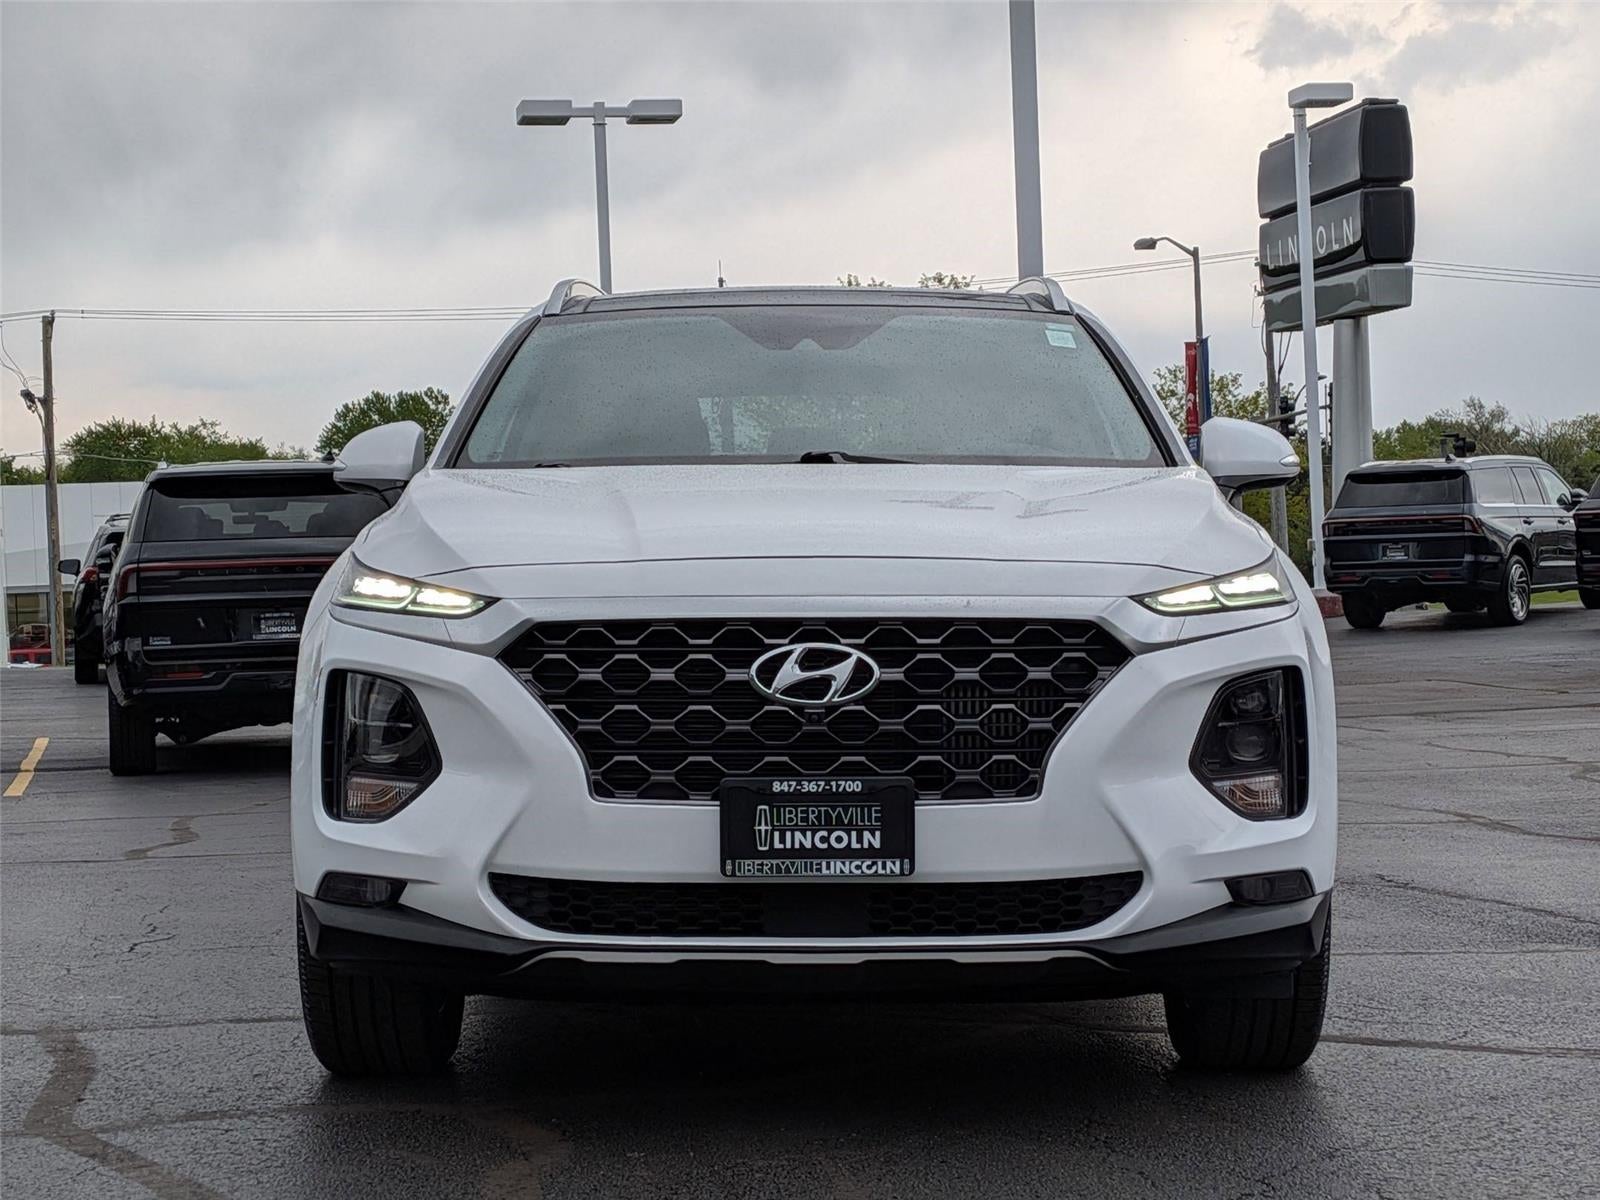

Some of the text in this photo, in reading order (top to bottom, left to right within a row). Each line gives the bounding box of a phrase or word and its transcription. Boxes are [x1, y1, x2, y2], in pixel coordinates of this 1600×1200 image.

[1266, 216, 1354, 270] LINOLN
[772, 781, 862, 792] 847-367-1700
[773, 806, 882, 826] LIBERTYVILLE
[773, 830, 881, 849] LINCOLN
